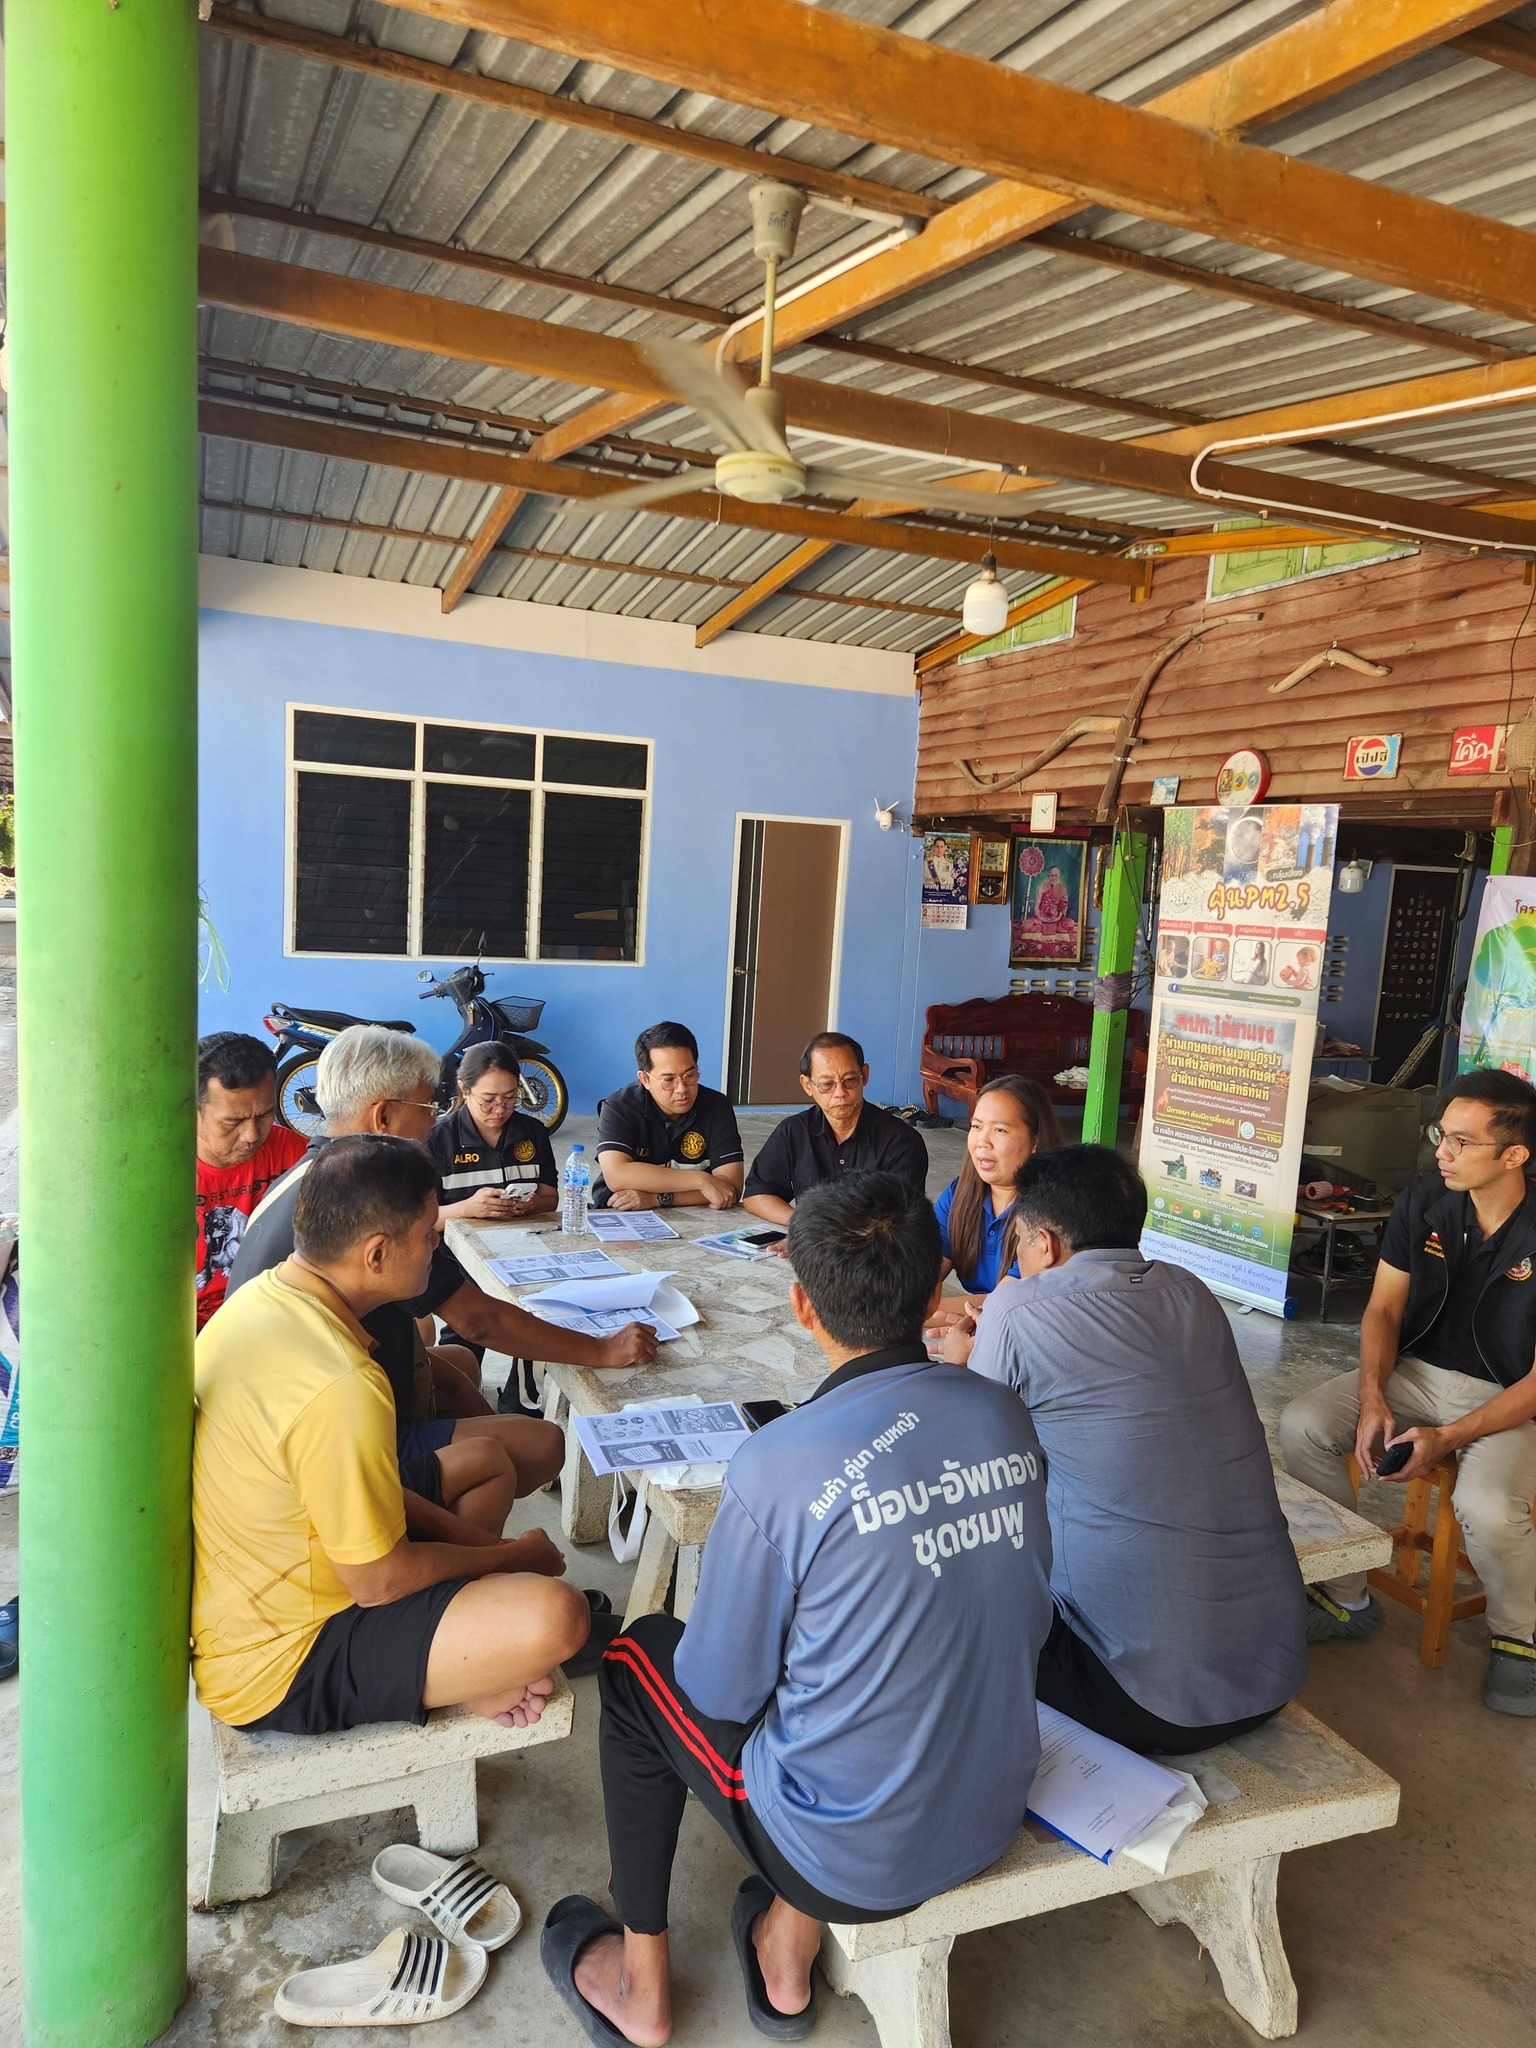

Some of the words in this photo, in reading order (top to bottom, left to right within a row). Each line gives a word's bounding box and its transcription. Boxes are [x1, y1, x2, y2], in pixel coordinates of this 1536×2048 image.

[1167, 1054, 1276, 1084] เผาเศษวัสดุทางการเกษตร
[1171, 1070, 1269, 1101] ฝ่าฝืนเพิกถอนสิทธิทันที
[454, 1153, 480, 1164] ALRO
[808, 1476, 848, 1521] สินค้า
[843, 1449, 875, 1481] คู่นา
[871, 1411, 921, 1454] คุมหญ้า
[912, 1501, 1025, 1579] ชุดชมพู
